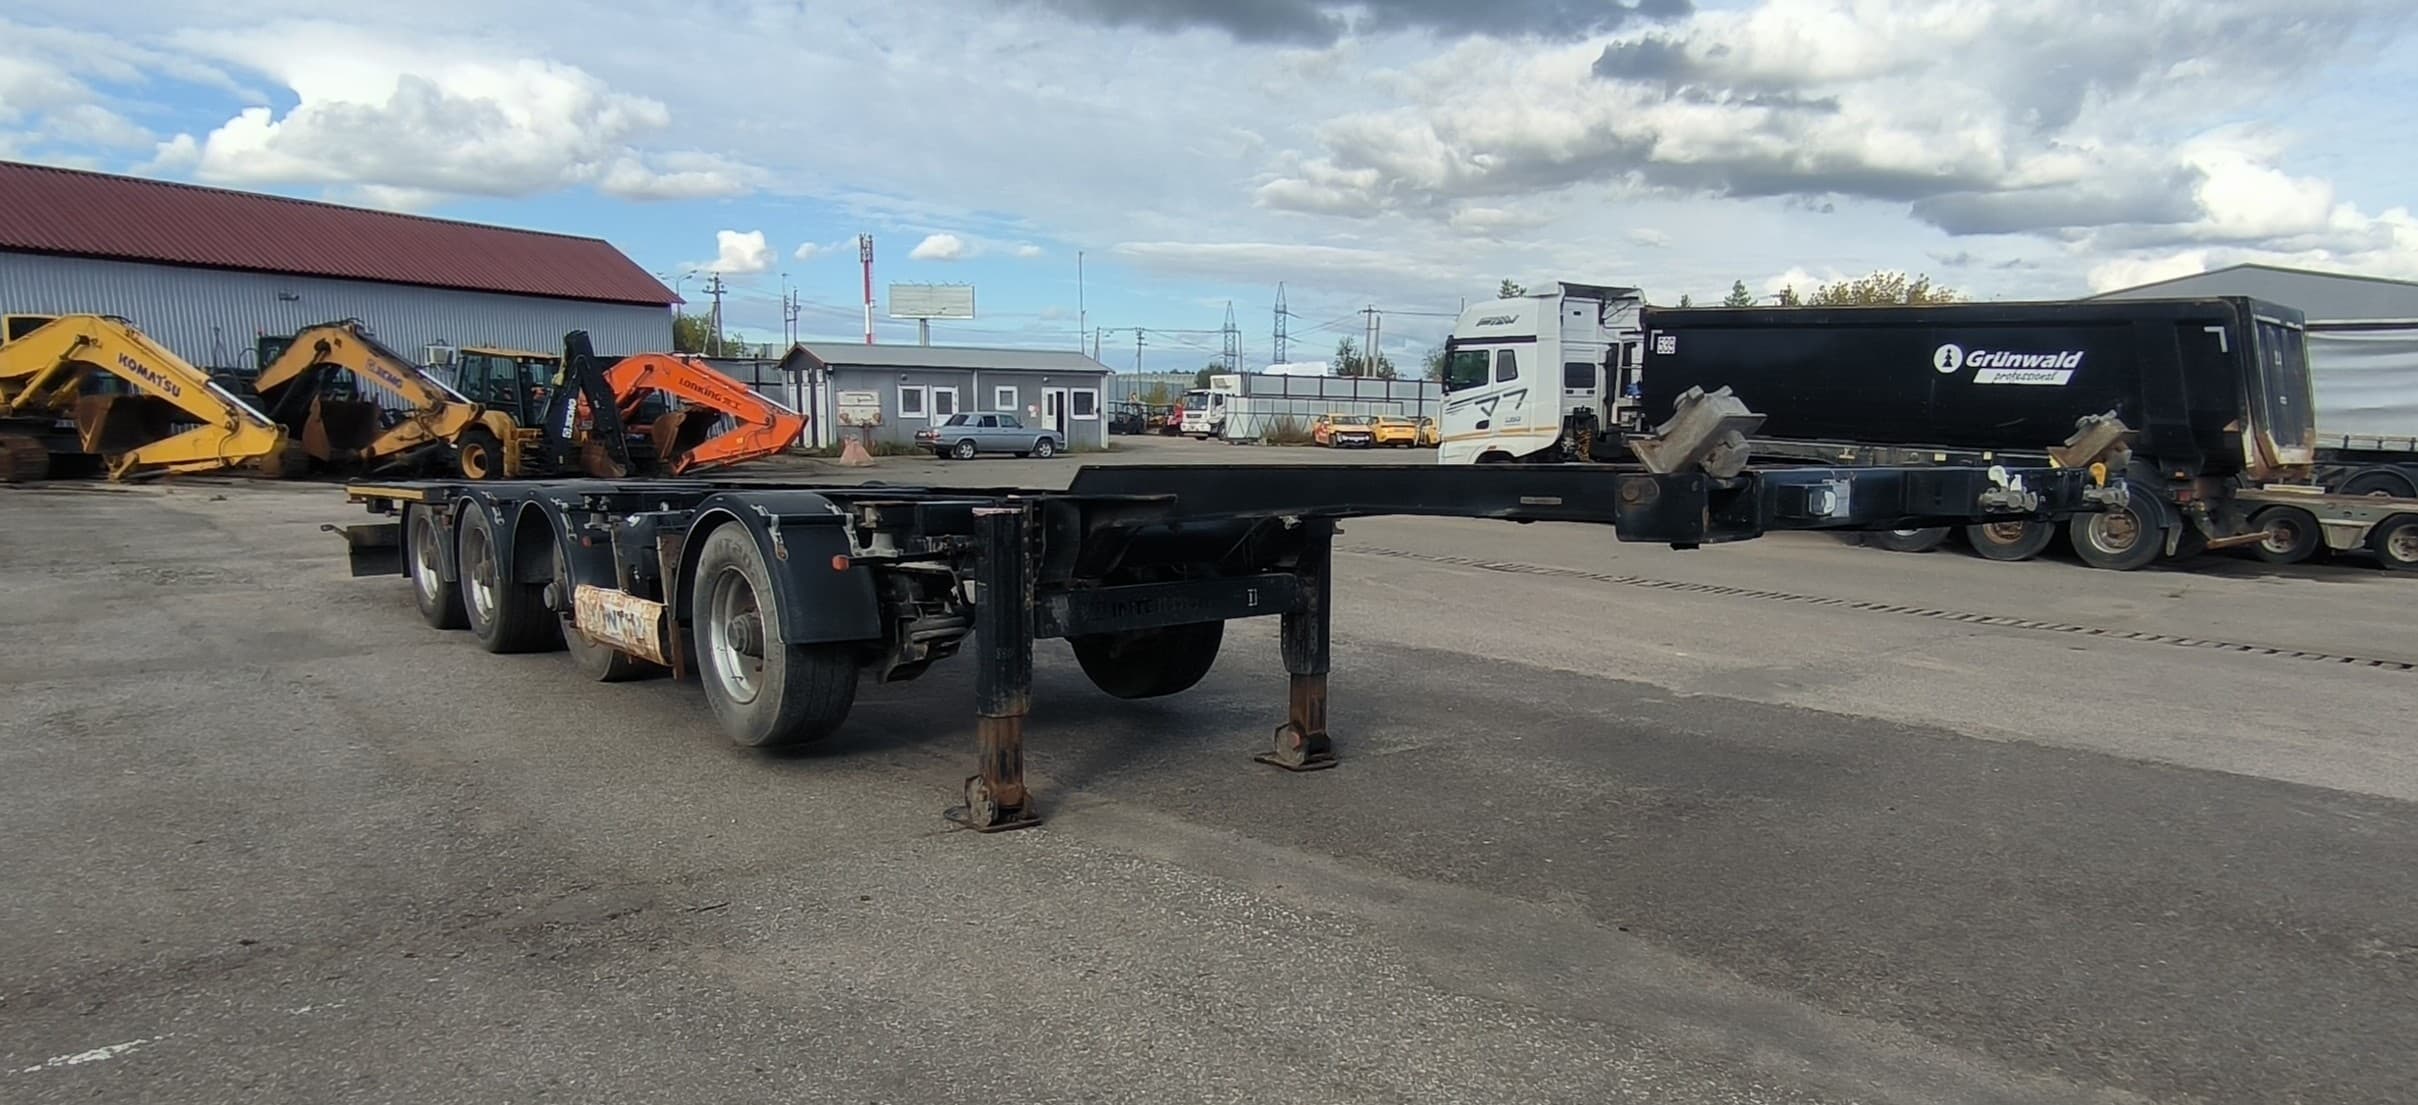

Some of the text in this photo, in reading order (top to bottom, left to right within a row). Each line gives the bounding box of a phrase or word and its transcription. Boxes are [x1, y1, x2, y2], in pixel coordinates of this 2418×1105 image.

[1965, 350, 2084, 368] Grünwald
[118, 352, 181, 398] KOMATSU
[1991, 371, 2059, 385] professional
[679, 378, 721, 402] LONKING
